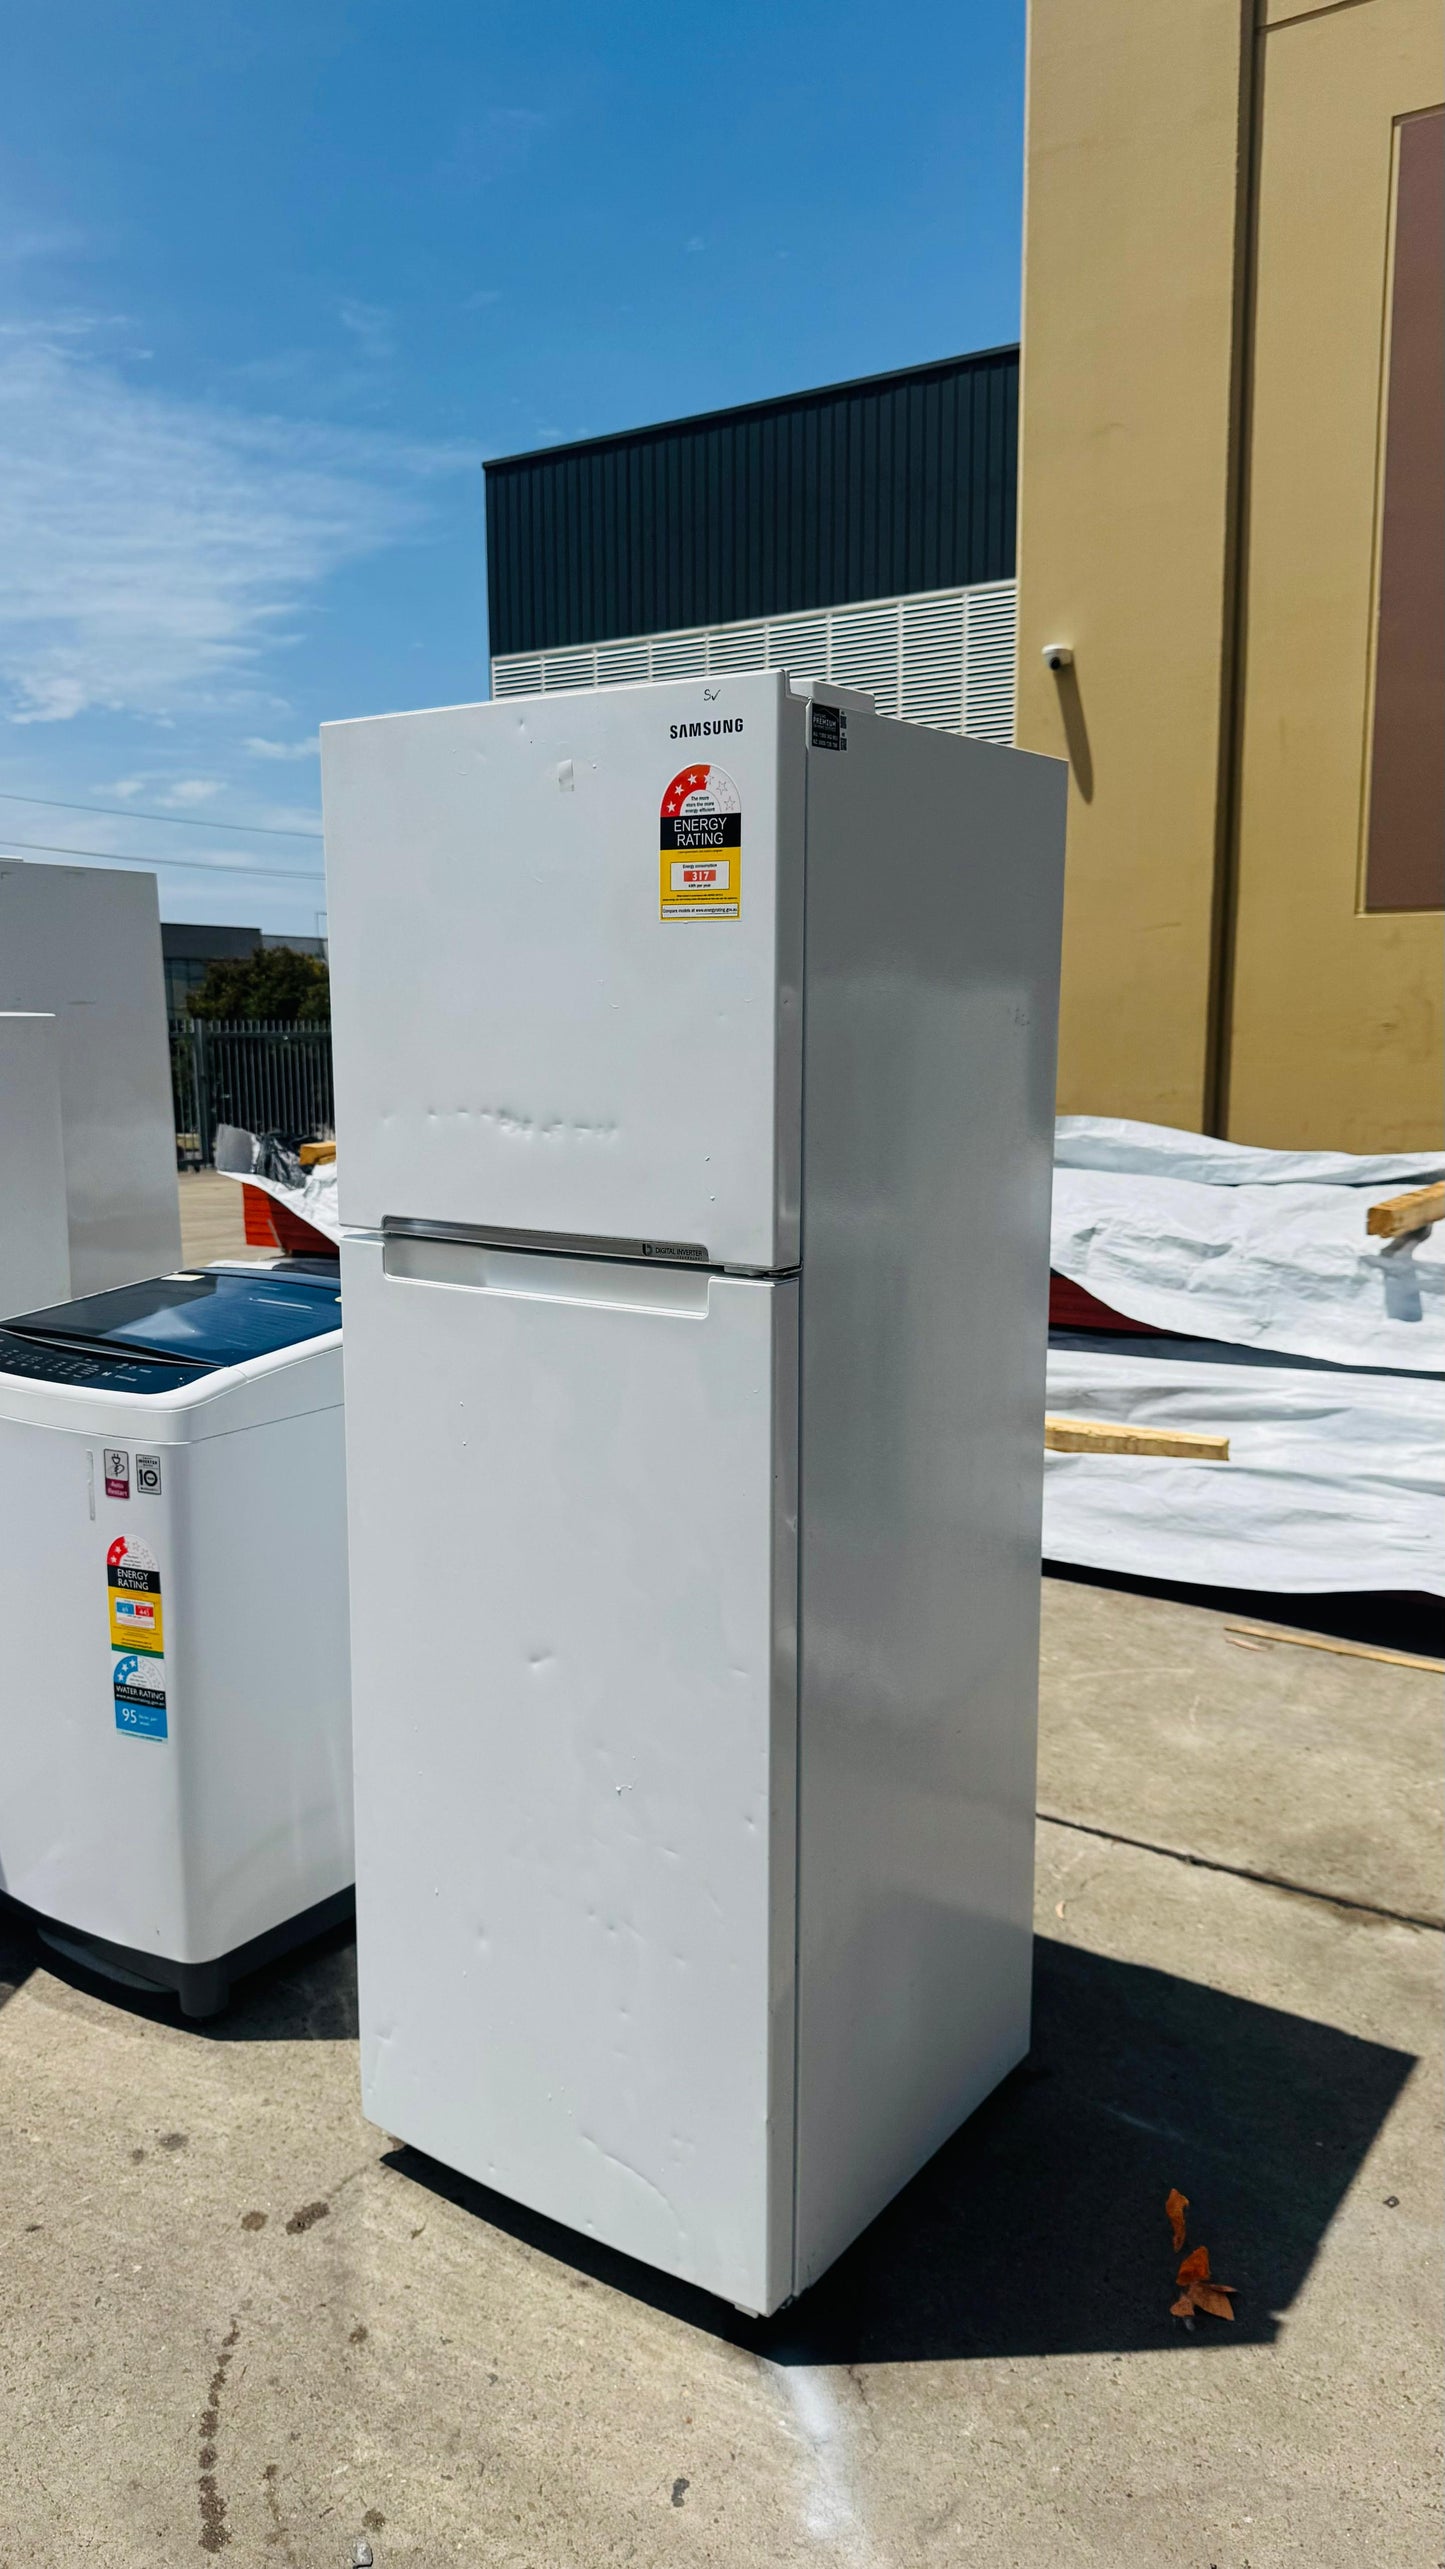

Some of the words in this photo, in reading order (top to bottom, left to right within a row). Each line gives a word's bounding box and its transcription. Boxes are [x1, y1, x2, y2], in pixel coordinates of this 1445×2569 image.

[669, 718, 744, 739] SAMSUNG
[673, 817, 727, 833] ENERGY
[677, 832, 724, 847] RATING
[692, 871, 710, 881] 317
[677, 1248, 703, 1256] INVERTER
[117, 1568, 149, 1581] ENERGY
[118, 1577, 149, 1591] RATING
[115, 1685, 138, 1696] WATER
[138, 1689, 165, 1700] RATING
[122, 1708, 137, 1724] 95
